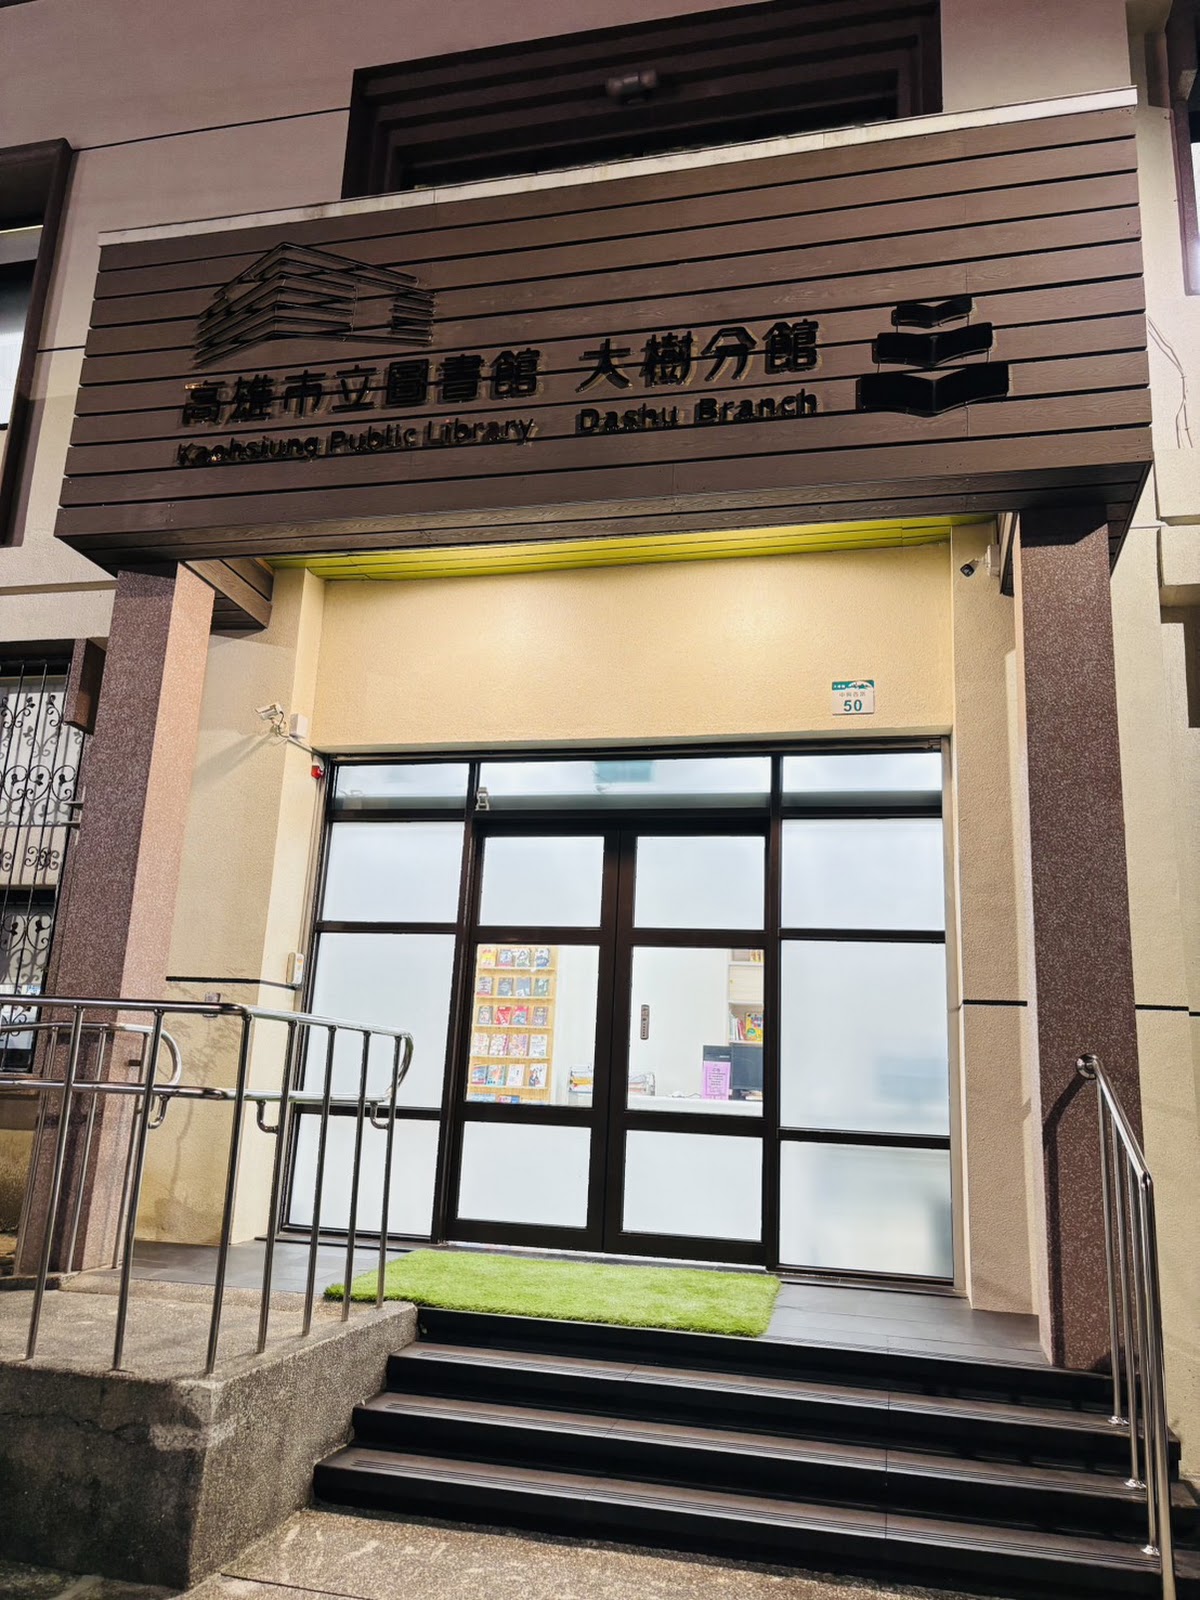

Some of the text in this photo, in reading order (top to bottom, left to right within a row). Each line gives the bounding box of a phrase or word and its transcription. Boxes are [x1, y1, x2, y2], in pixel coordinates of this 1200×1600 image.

[183, 318, 820, 425] 高雄市立圖書館 大樹分館
[177, 388, 818, 466] Kaohsiung Public Library Dashu Branch
[843, 699, 863, 712] 50
